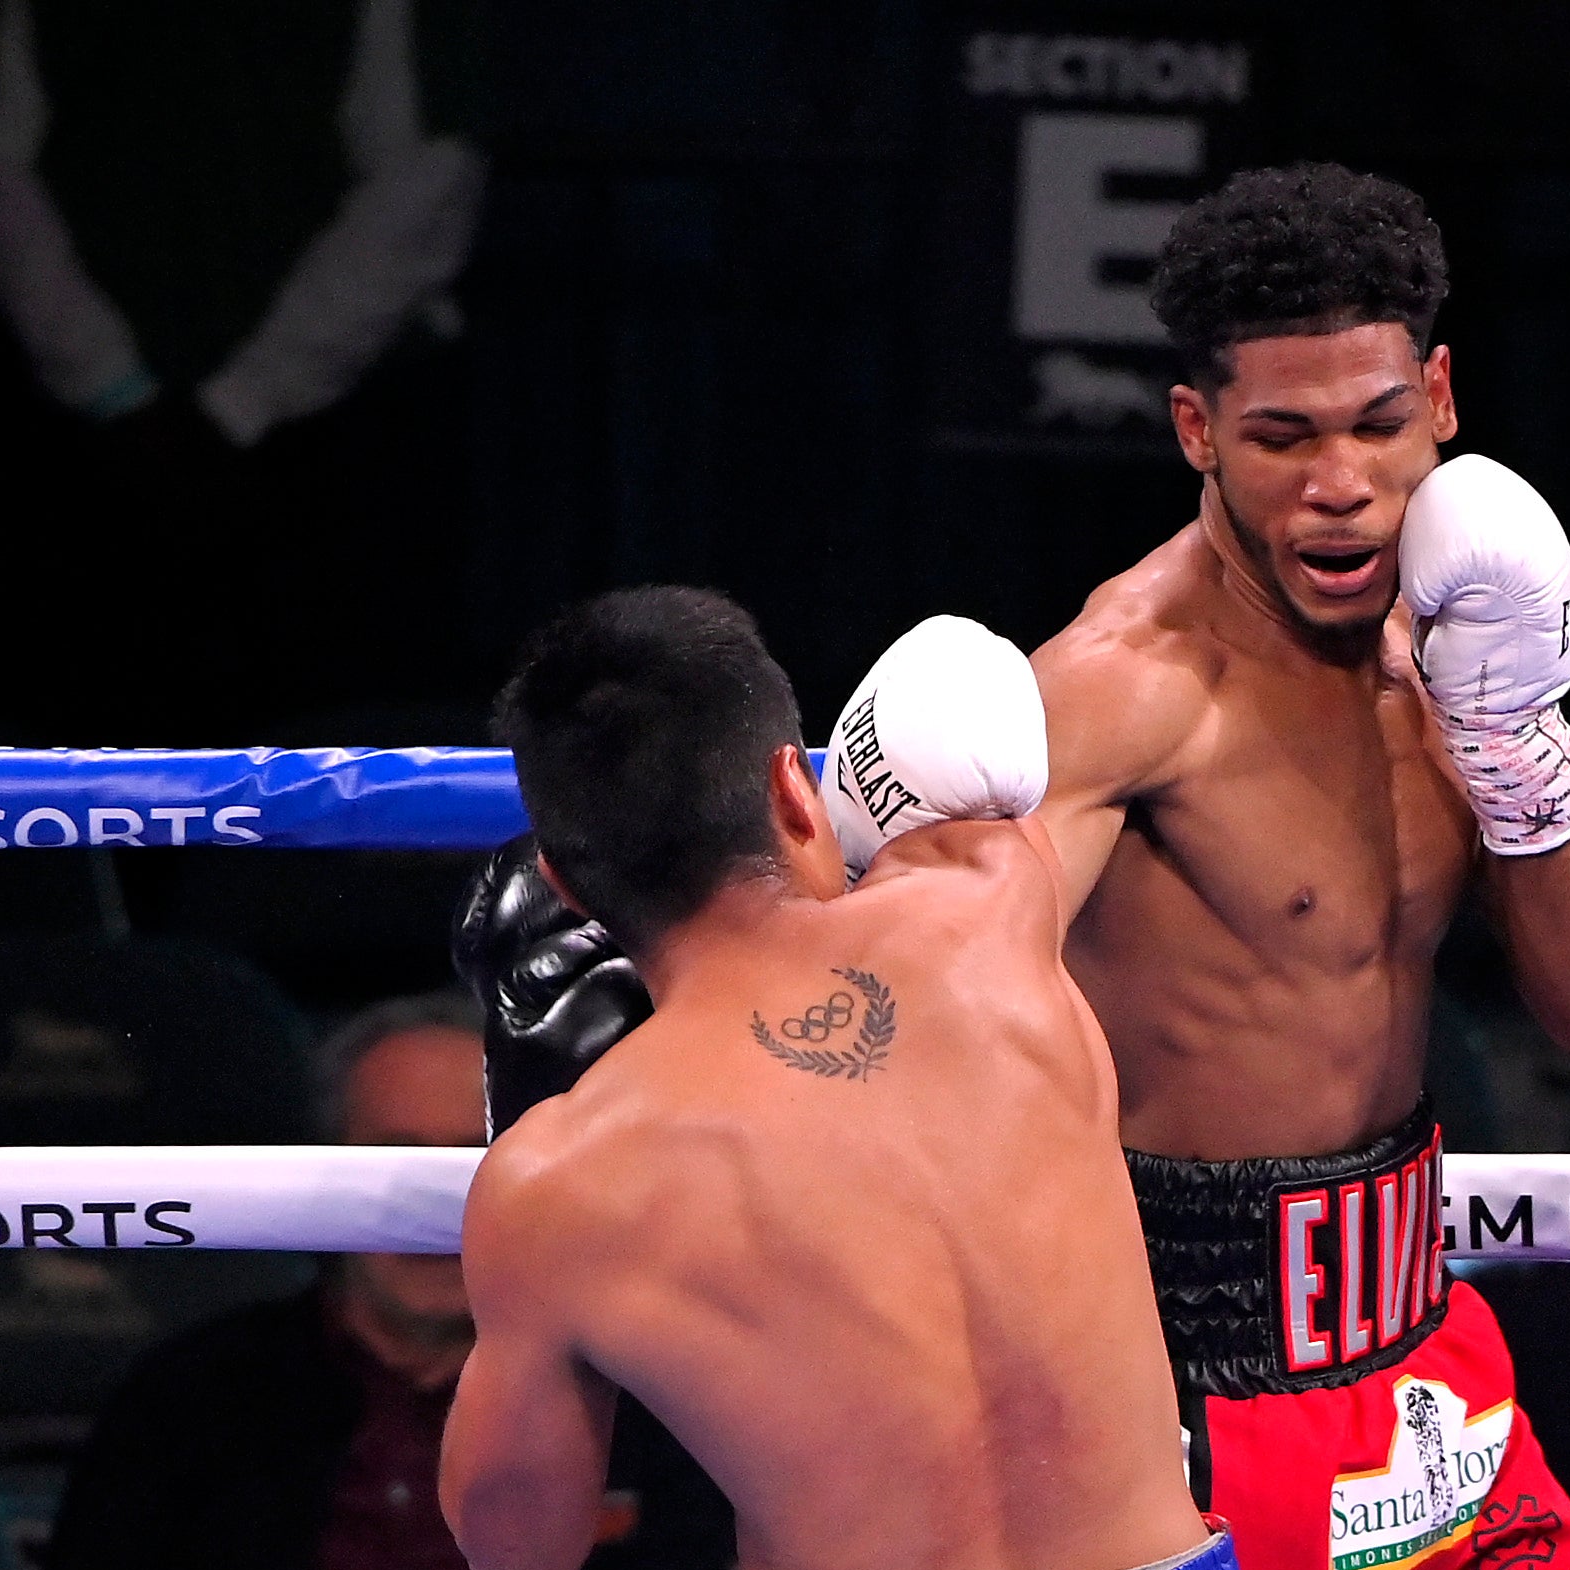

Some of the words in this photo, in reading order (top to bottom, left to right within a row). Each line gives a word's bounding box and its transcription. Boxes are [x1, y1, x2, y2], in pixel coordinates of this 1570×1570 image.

[962, 28, 1252, 101] SECTION
[842, 688, 921, 837] EVERLAST
[1330, 1488, 1428, 1541] Santa
